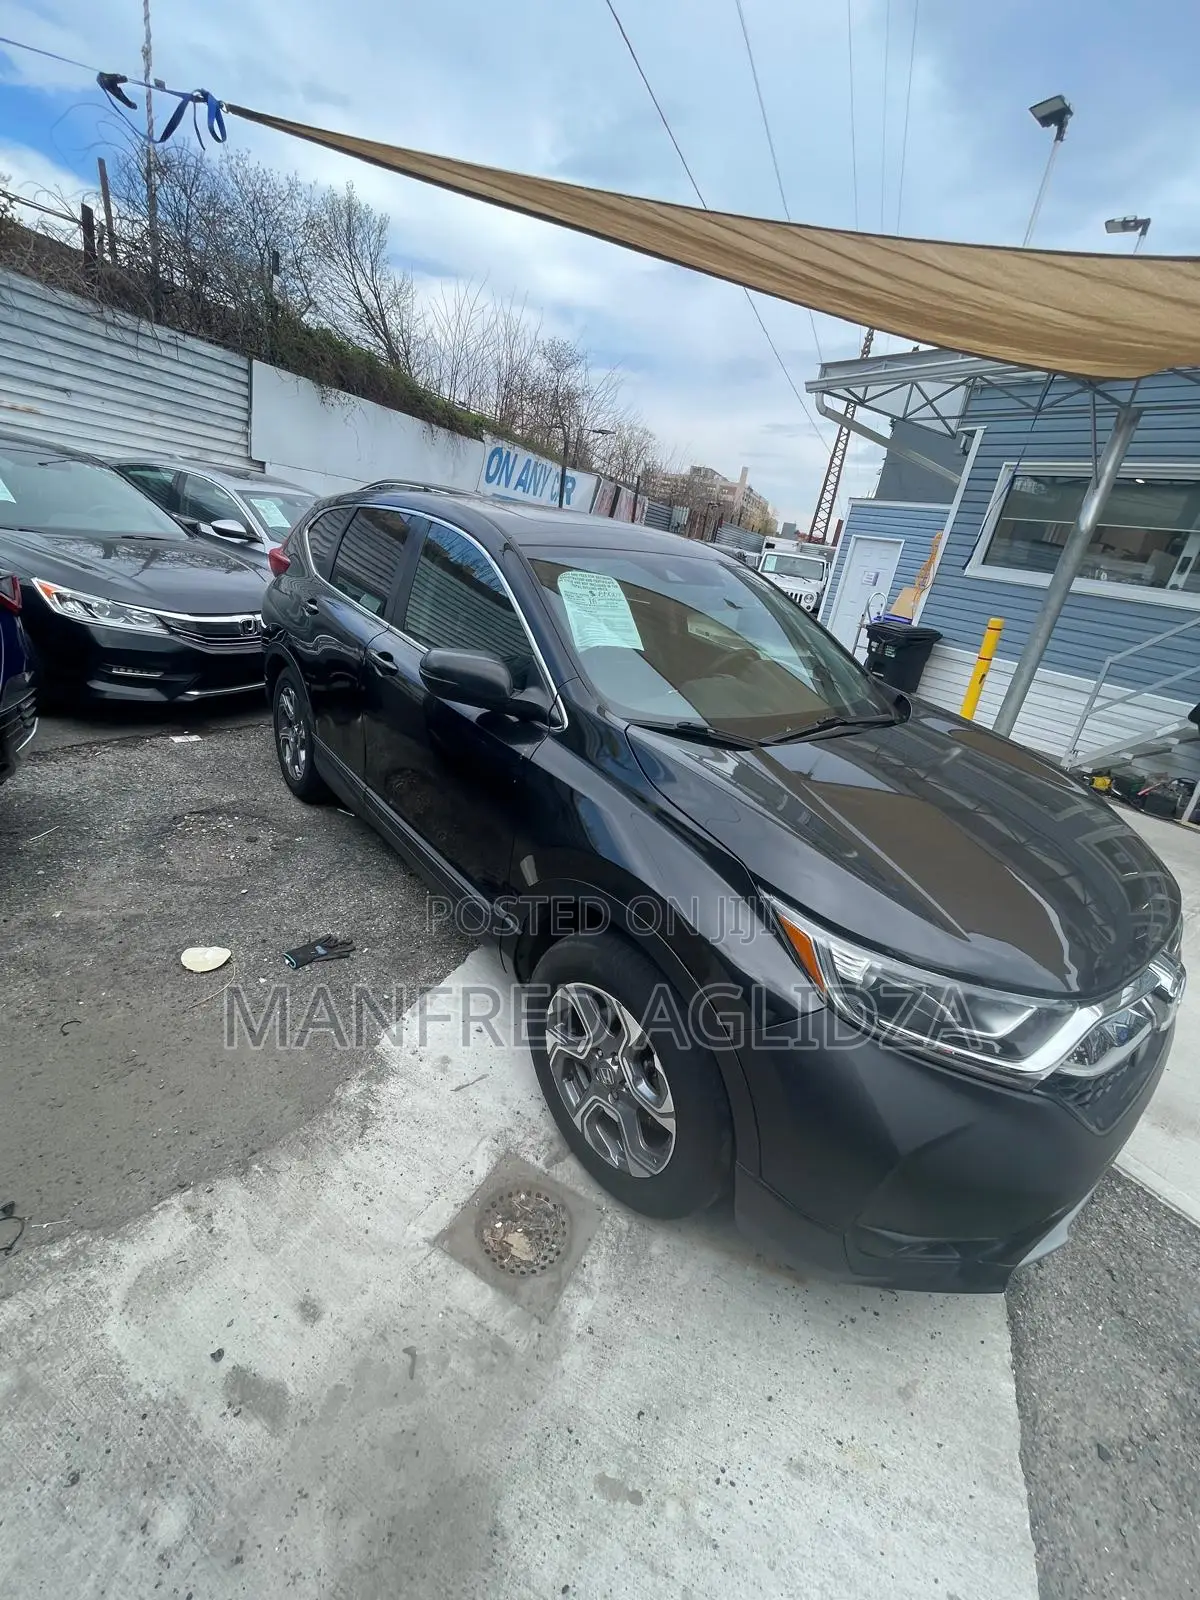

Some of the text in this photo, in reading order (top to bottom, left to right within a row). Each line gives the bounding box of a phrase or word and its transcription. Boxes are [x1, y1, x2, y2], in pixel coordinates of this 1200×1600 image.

[485, 447, 576, 506] ON ANY CR
